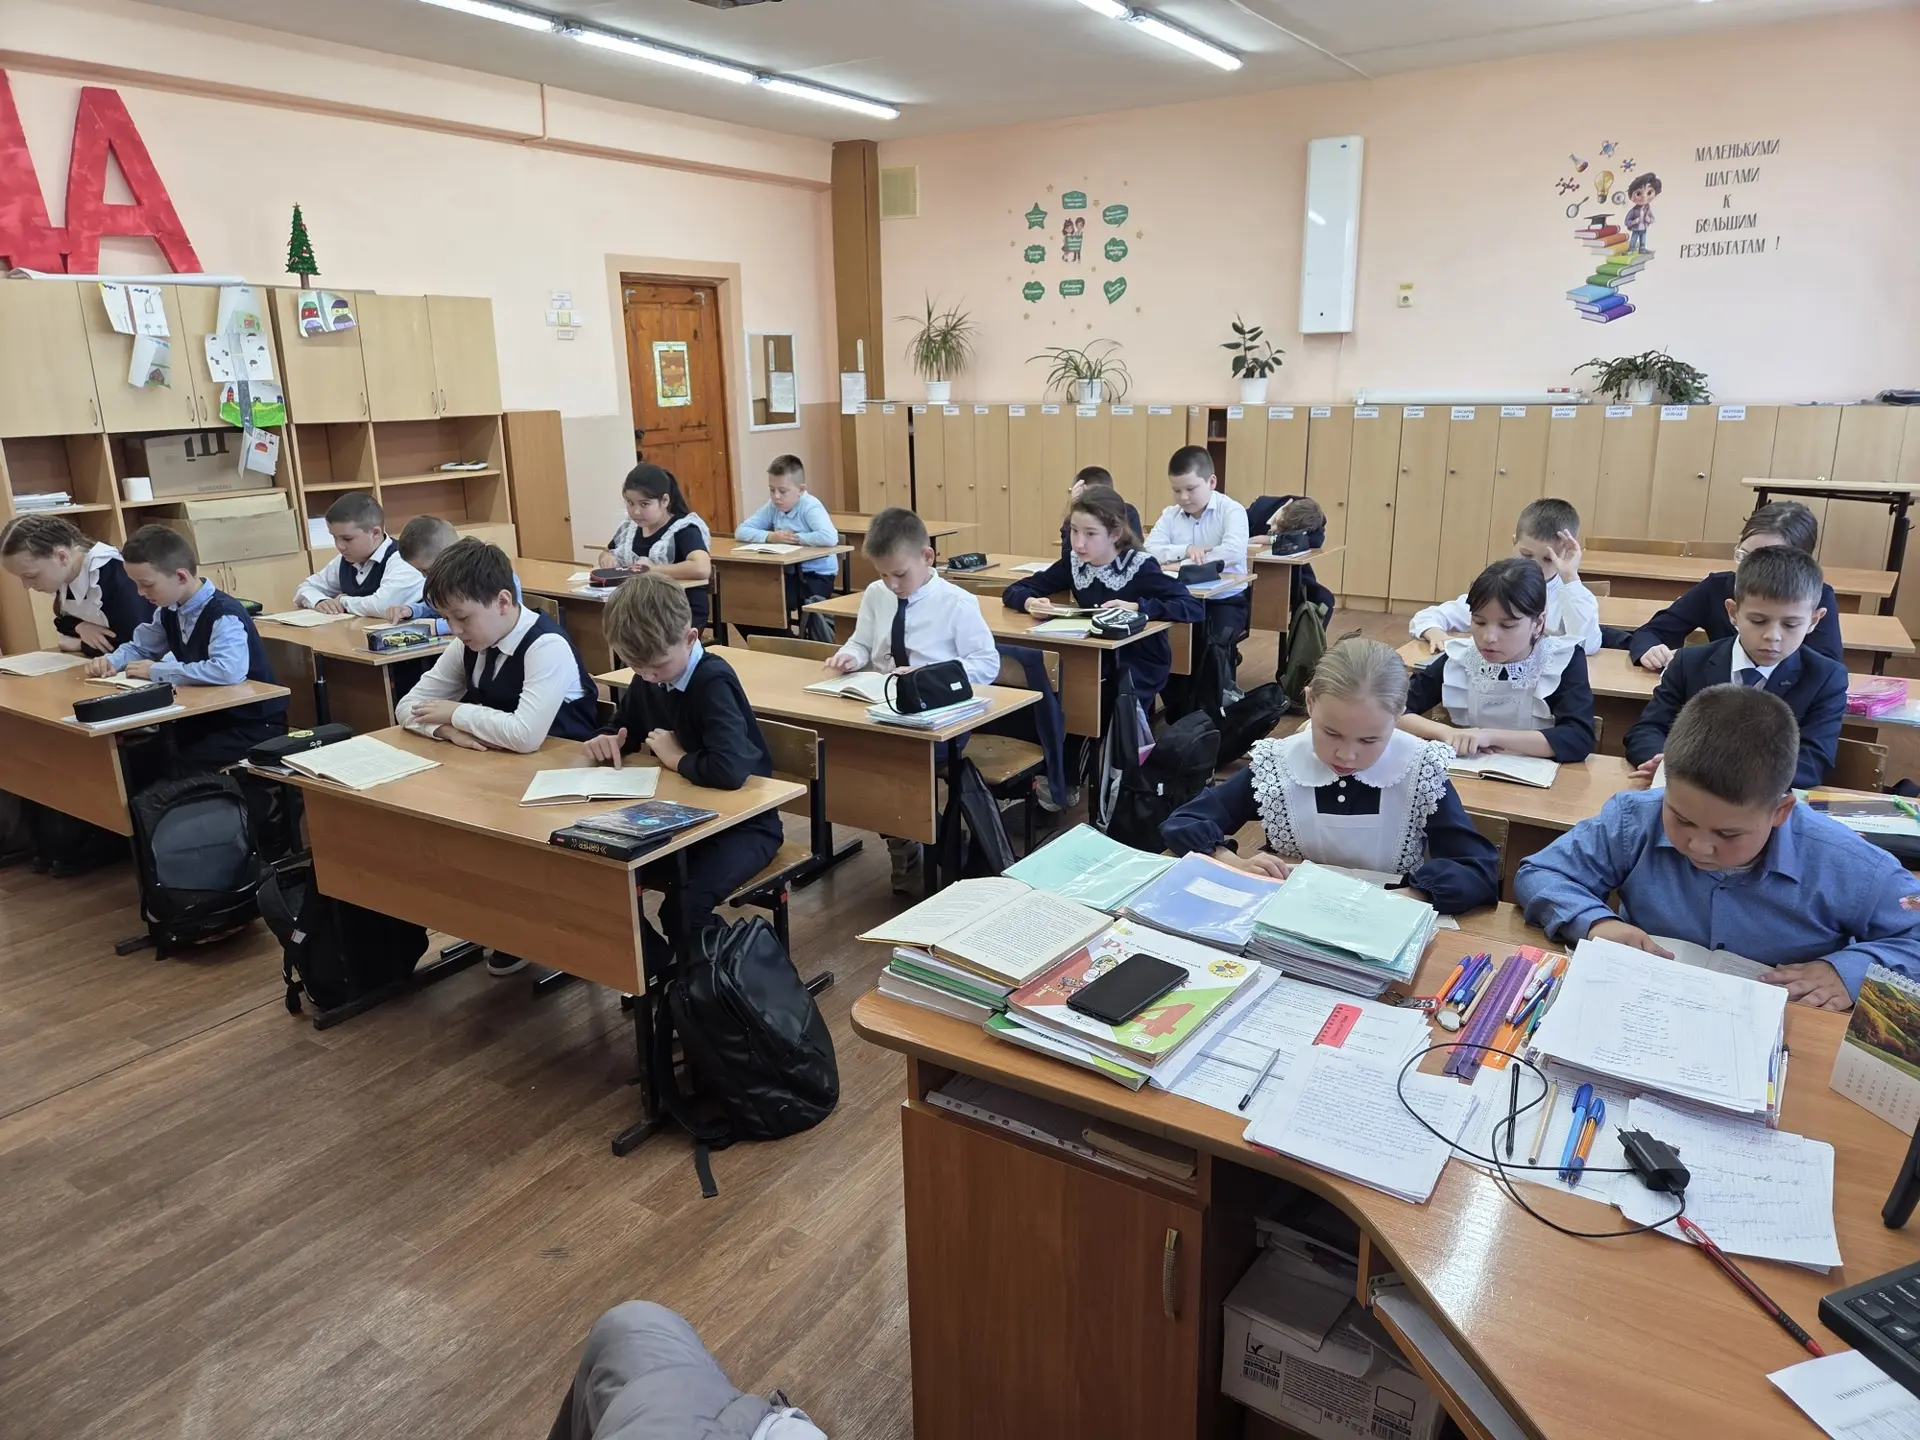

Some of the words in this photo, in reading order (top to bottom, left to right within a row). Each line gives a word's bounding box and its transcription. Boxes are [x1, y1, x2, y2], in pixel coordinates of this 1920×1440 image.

[1694, 138, 1781, 163] МАЛЕНЬКИМИ
[1704, 167, 1761, 188] ШАГАМИ
[1722, 194, 1732, 209] К
[1694, 212, 1758, 234] БОЛЬШИМ
[1679, 238, 1766, 259] РЕЗУЛЬТАТАМ
[1130, 1002, 1196, 1038] 4
